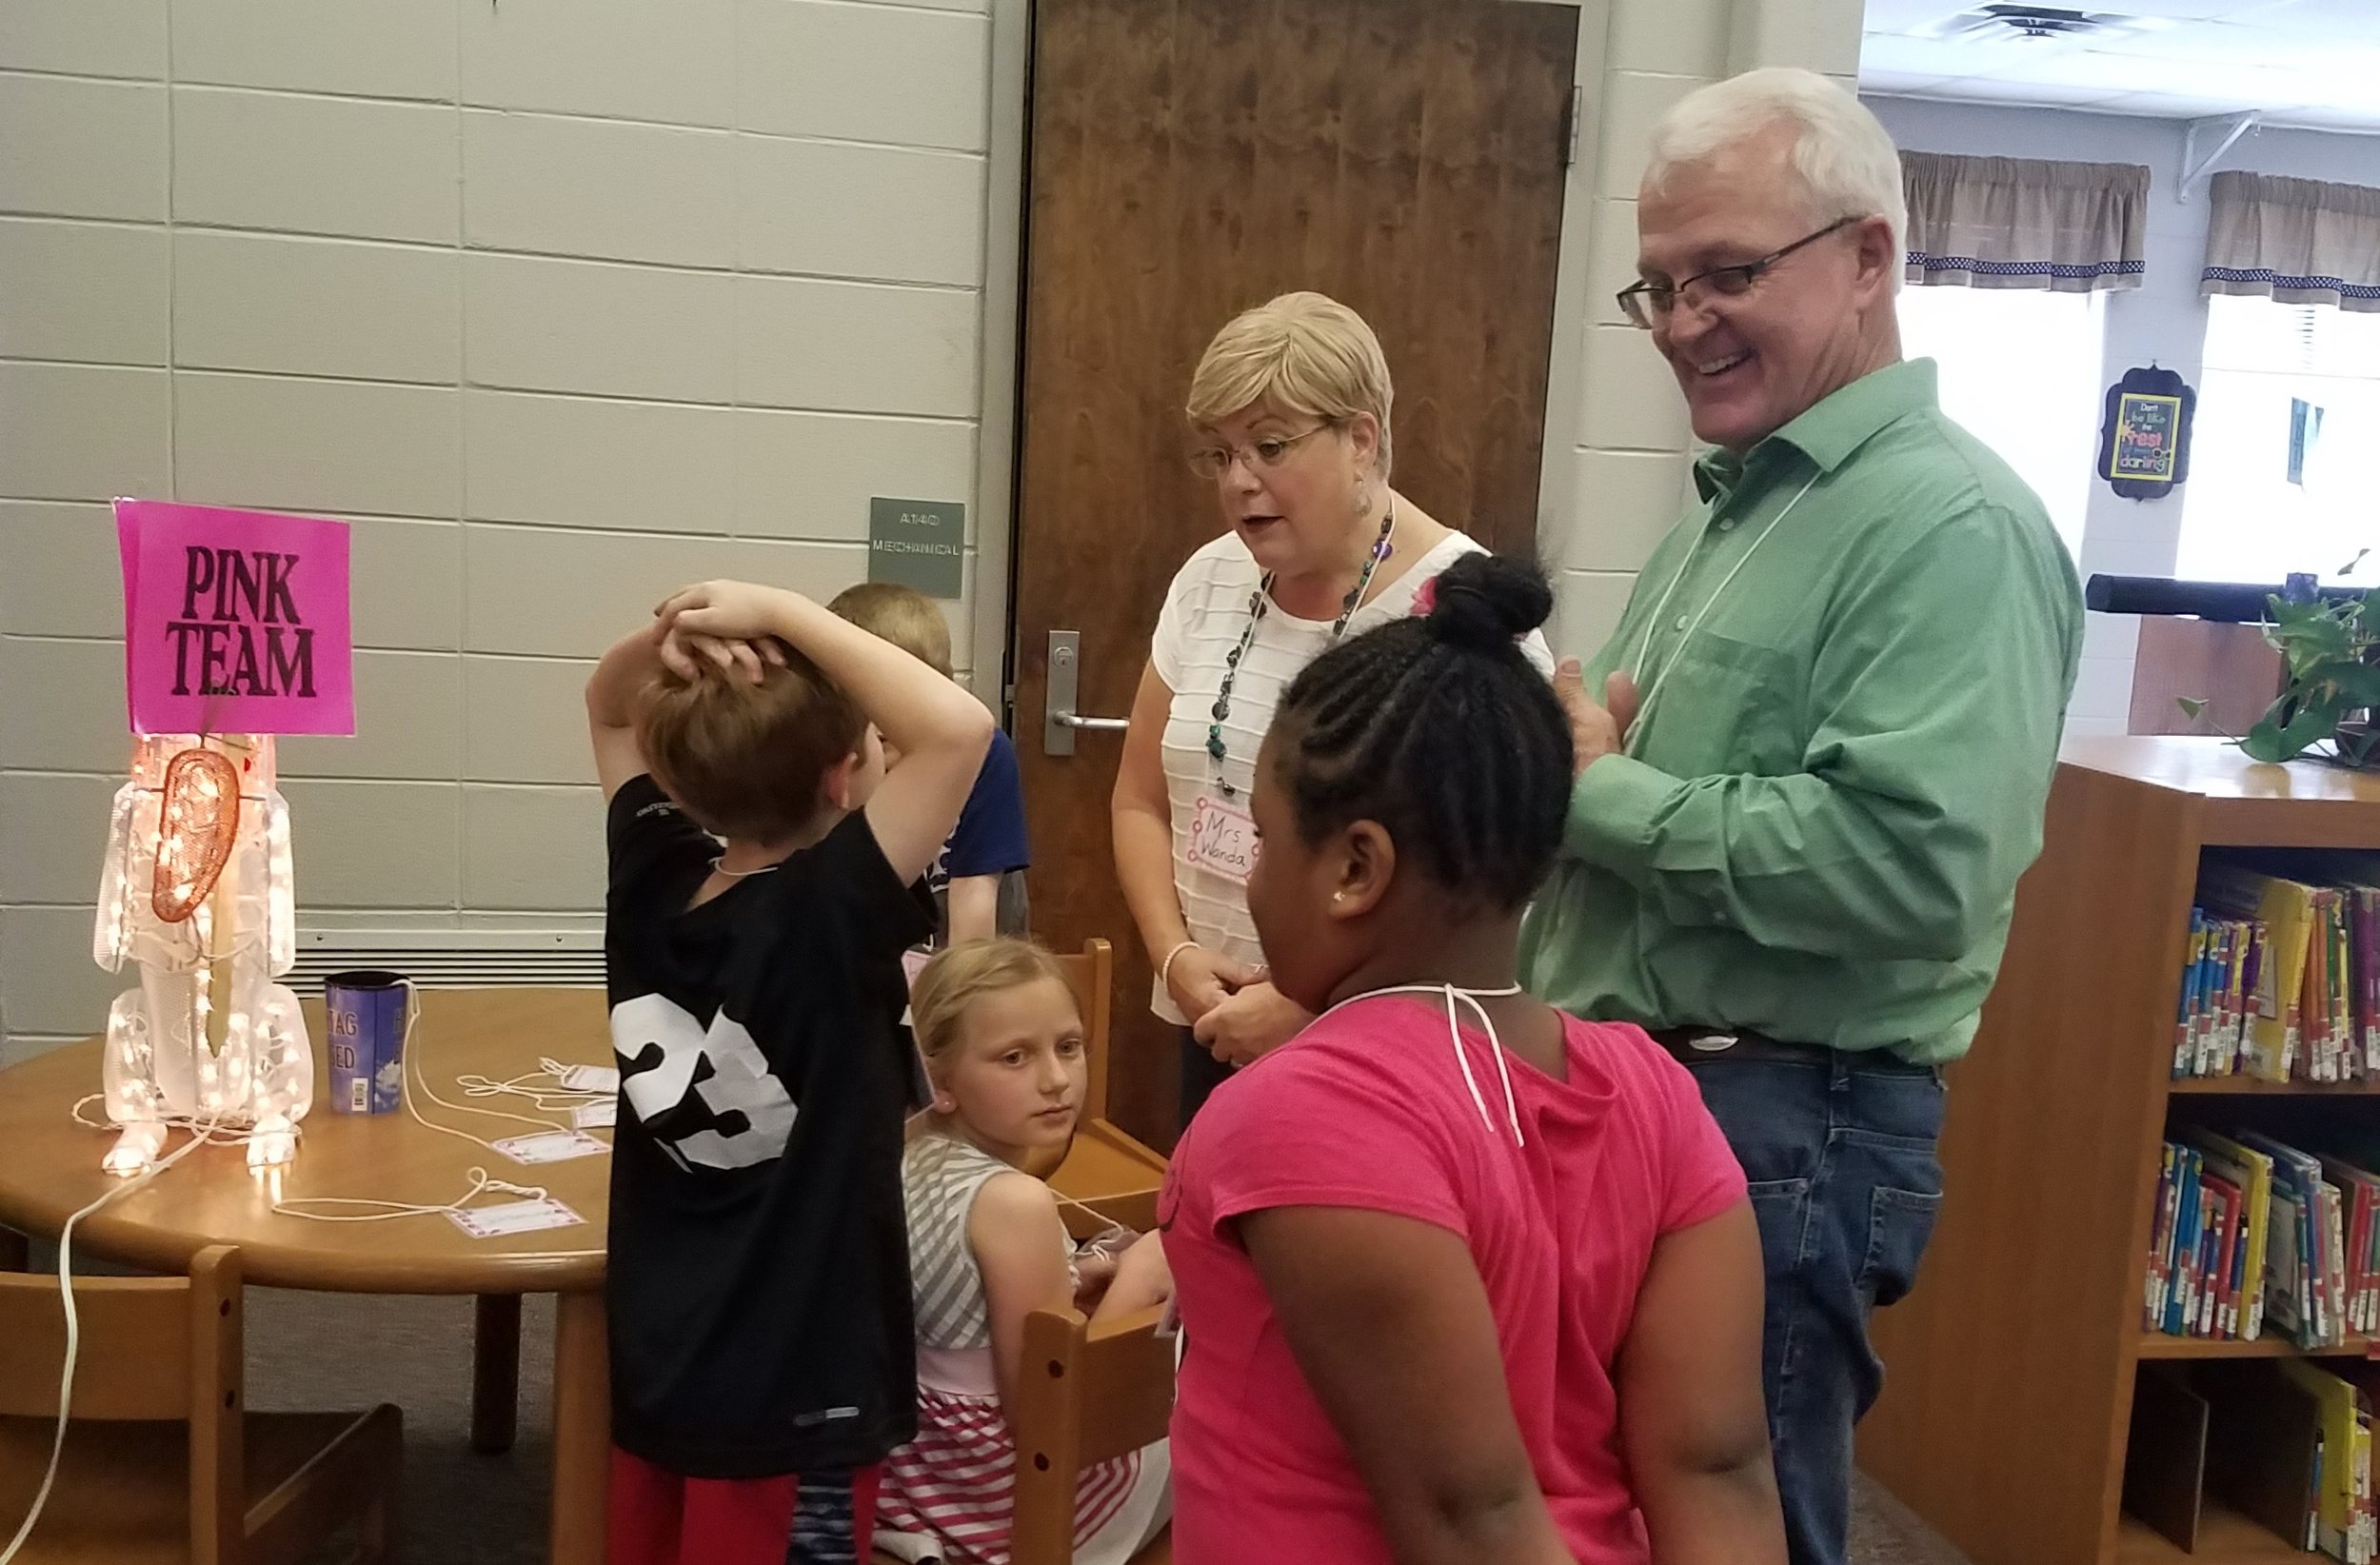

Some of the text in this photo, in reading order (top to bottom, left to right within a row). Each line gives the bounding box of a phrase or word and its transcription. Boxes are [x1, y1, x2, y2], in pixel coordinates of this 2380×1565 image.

[182, 545, 301, 624] PINK
[873, 540, 960, 556] MECHANICAL
[165, 622, 317, 698] TEAM
[1206, 811, 1241, 842] Mrs
[610, 992, 799, 1175] 23
